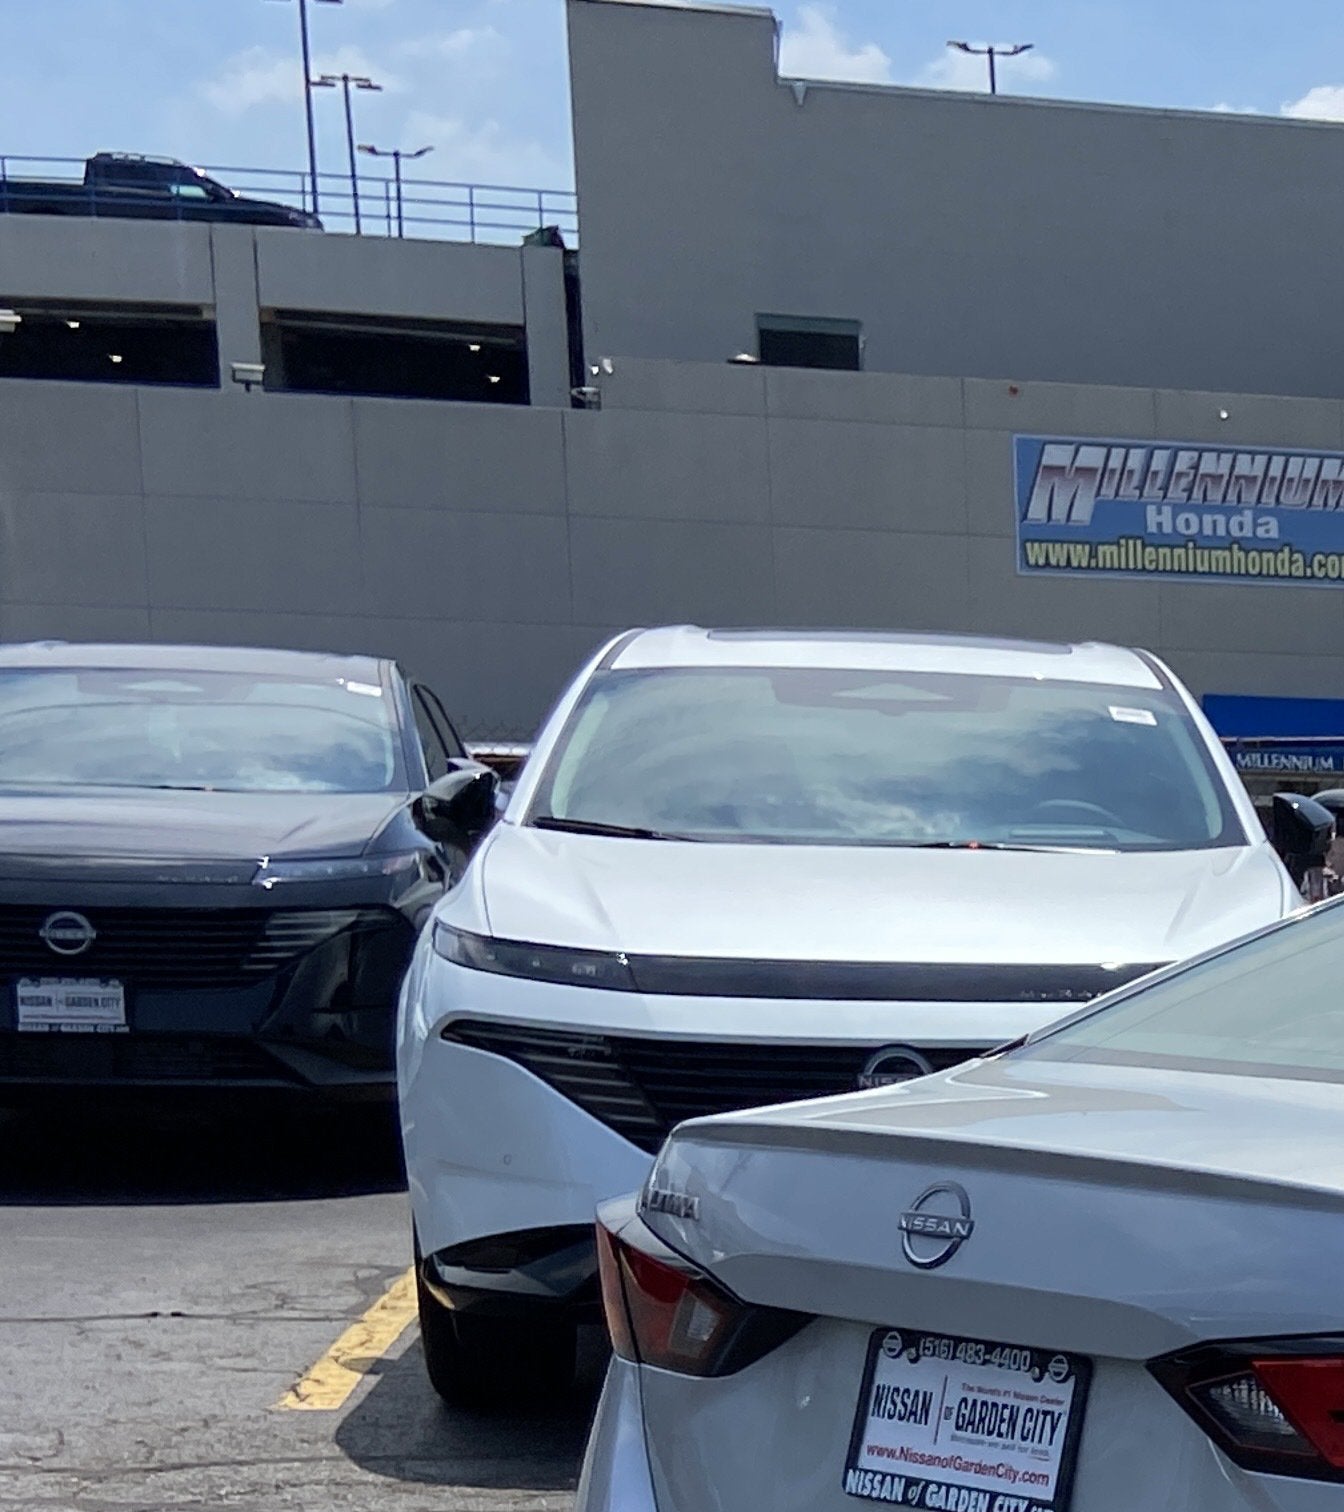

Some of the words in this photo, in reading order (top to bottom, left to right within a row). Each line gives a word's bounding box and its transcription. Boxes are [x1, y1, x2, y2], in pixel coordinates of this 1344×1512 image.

[1145, 505, 1280, 539] Honda
[901, 1215, 970, 1236] NISSAN
[957, 1342, 1031, 1372] 483-4400
[871, 1384, 933, 1426] NISSAN
[955, 1396, 1020, 1440] GARDEN
[1021, 1407, 1063, 1446] CITY
[866, 1443, 1050, 1487] www.NissanofGardenCity.com
[846, 1469, 904, 1502] NISSAN
[908, 1481, 924, 1506] of
